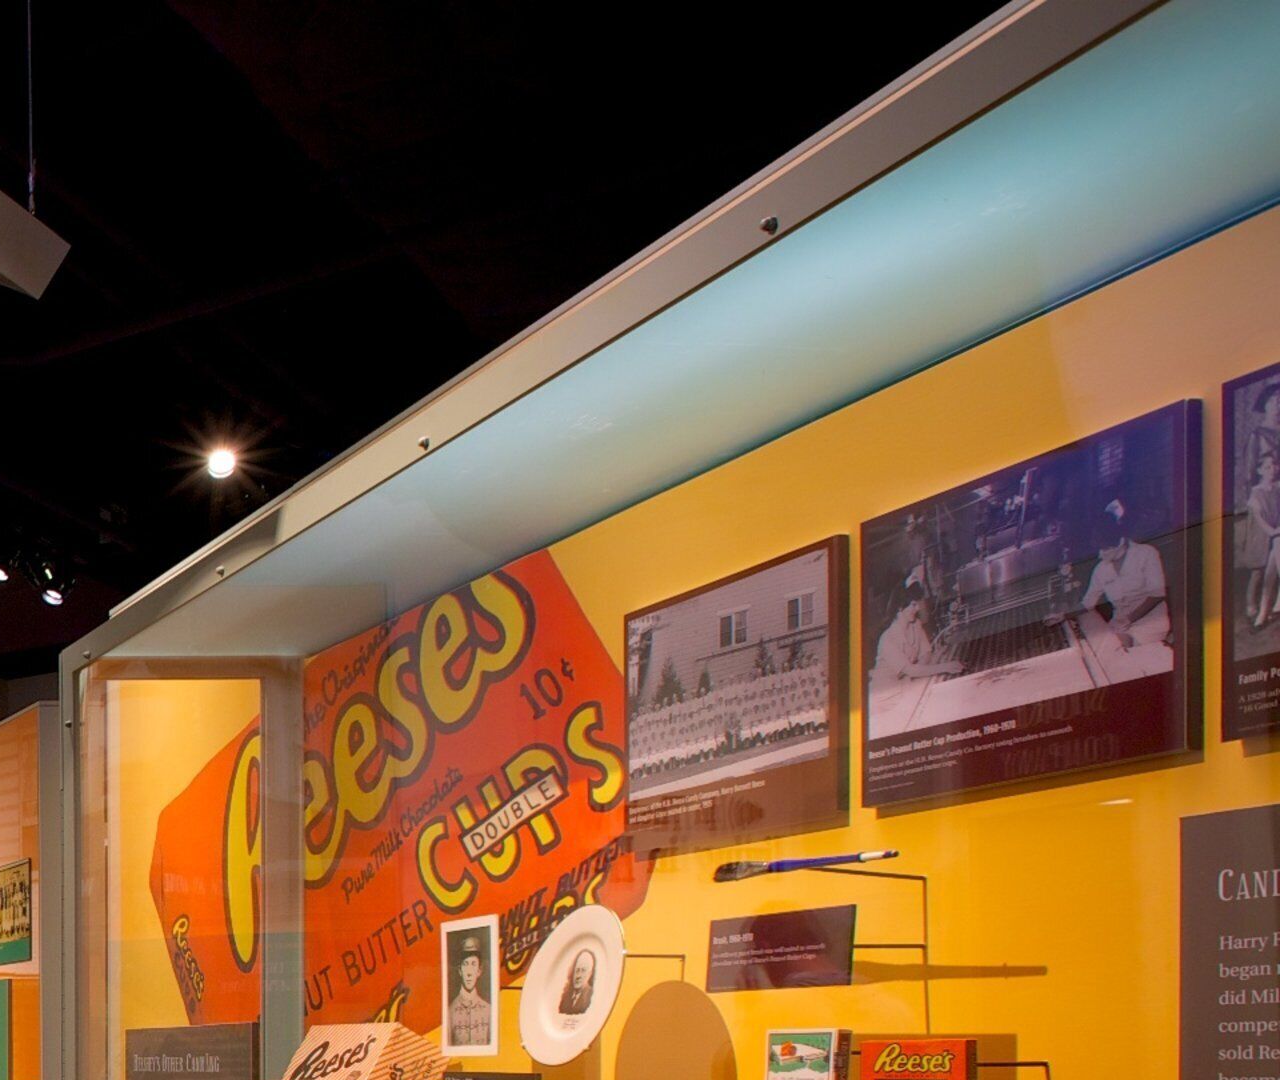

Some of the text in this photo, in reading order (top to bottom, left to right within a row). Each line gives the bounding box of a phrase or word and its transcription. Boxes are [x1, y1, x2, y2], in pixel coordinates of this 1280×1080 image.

[470, 780, 556, 851] DOUBLE
[341, 899, 434, 987] BUTTER
[1219, 934, 1268, 952] Harry
[1219, 962, 1272, 981] began
[1218, 989, 1246, 1005] did
[1218, 1018, 1280, 1036] compe
[873, 1042, 955, 1073] Reese's
[1218, 1045, 1254, 1061] sold
